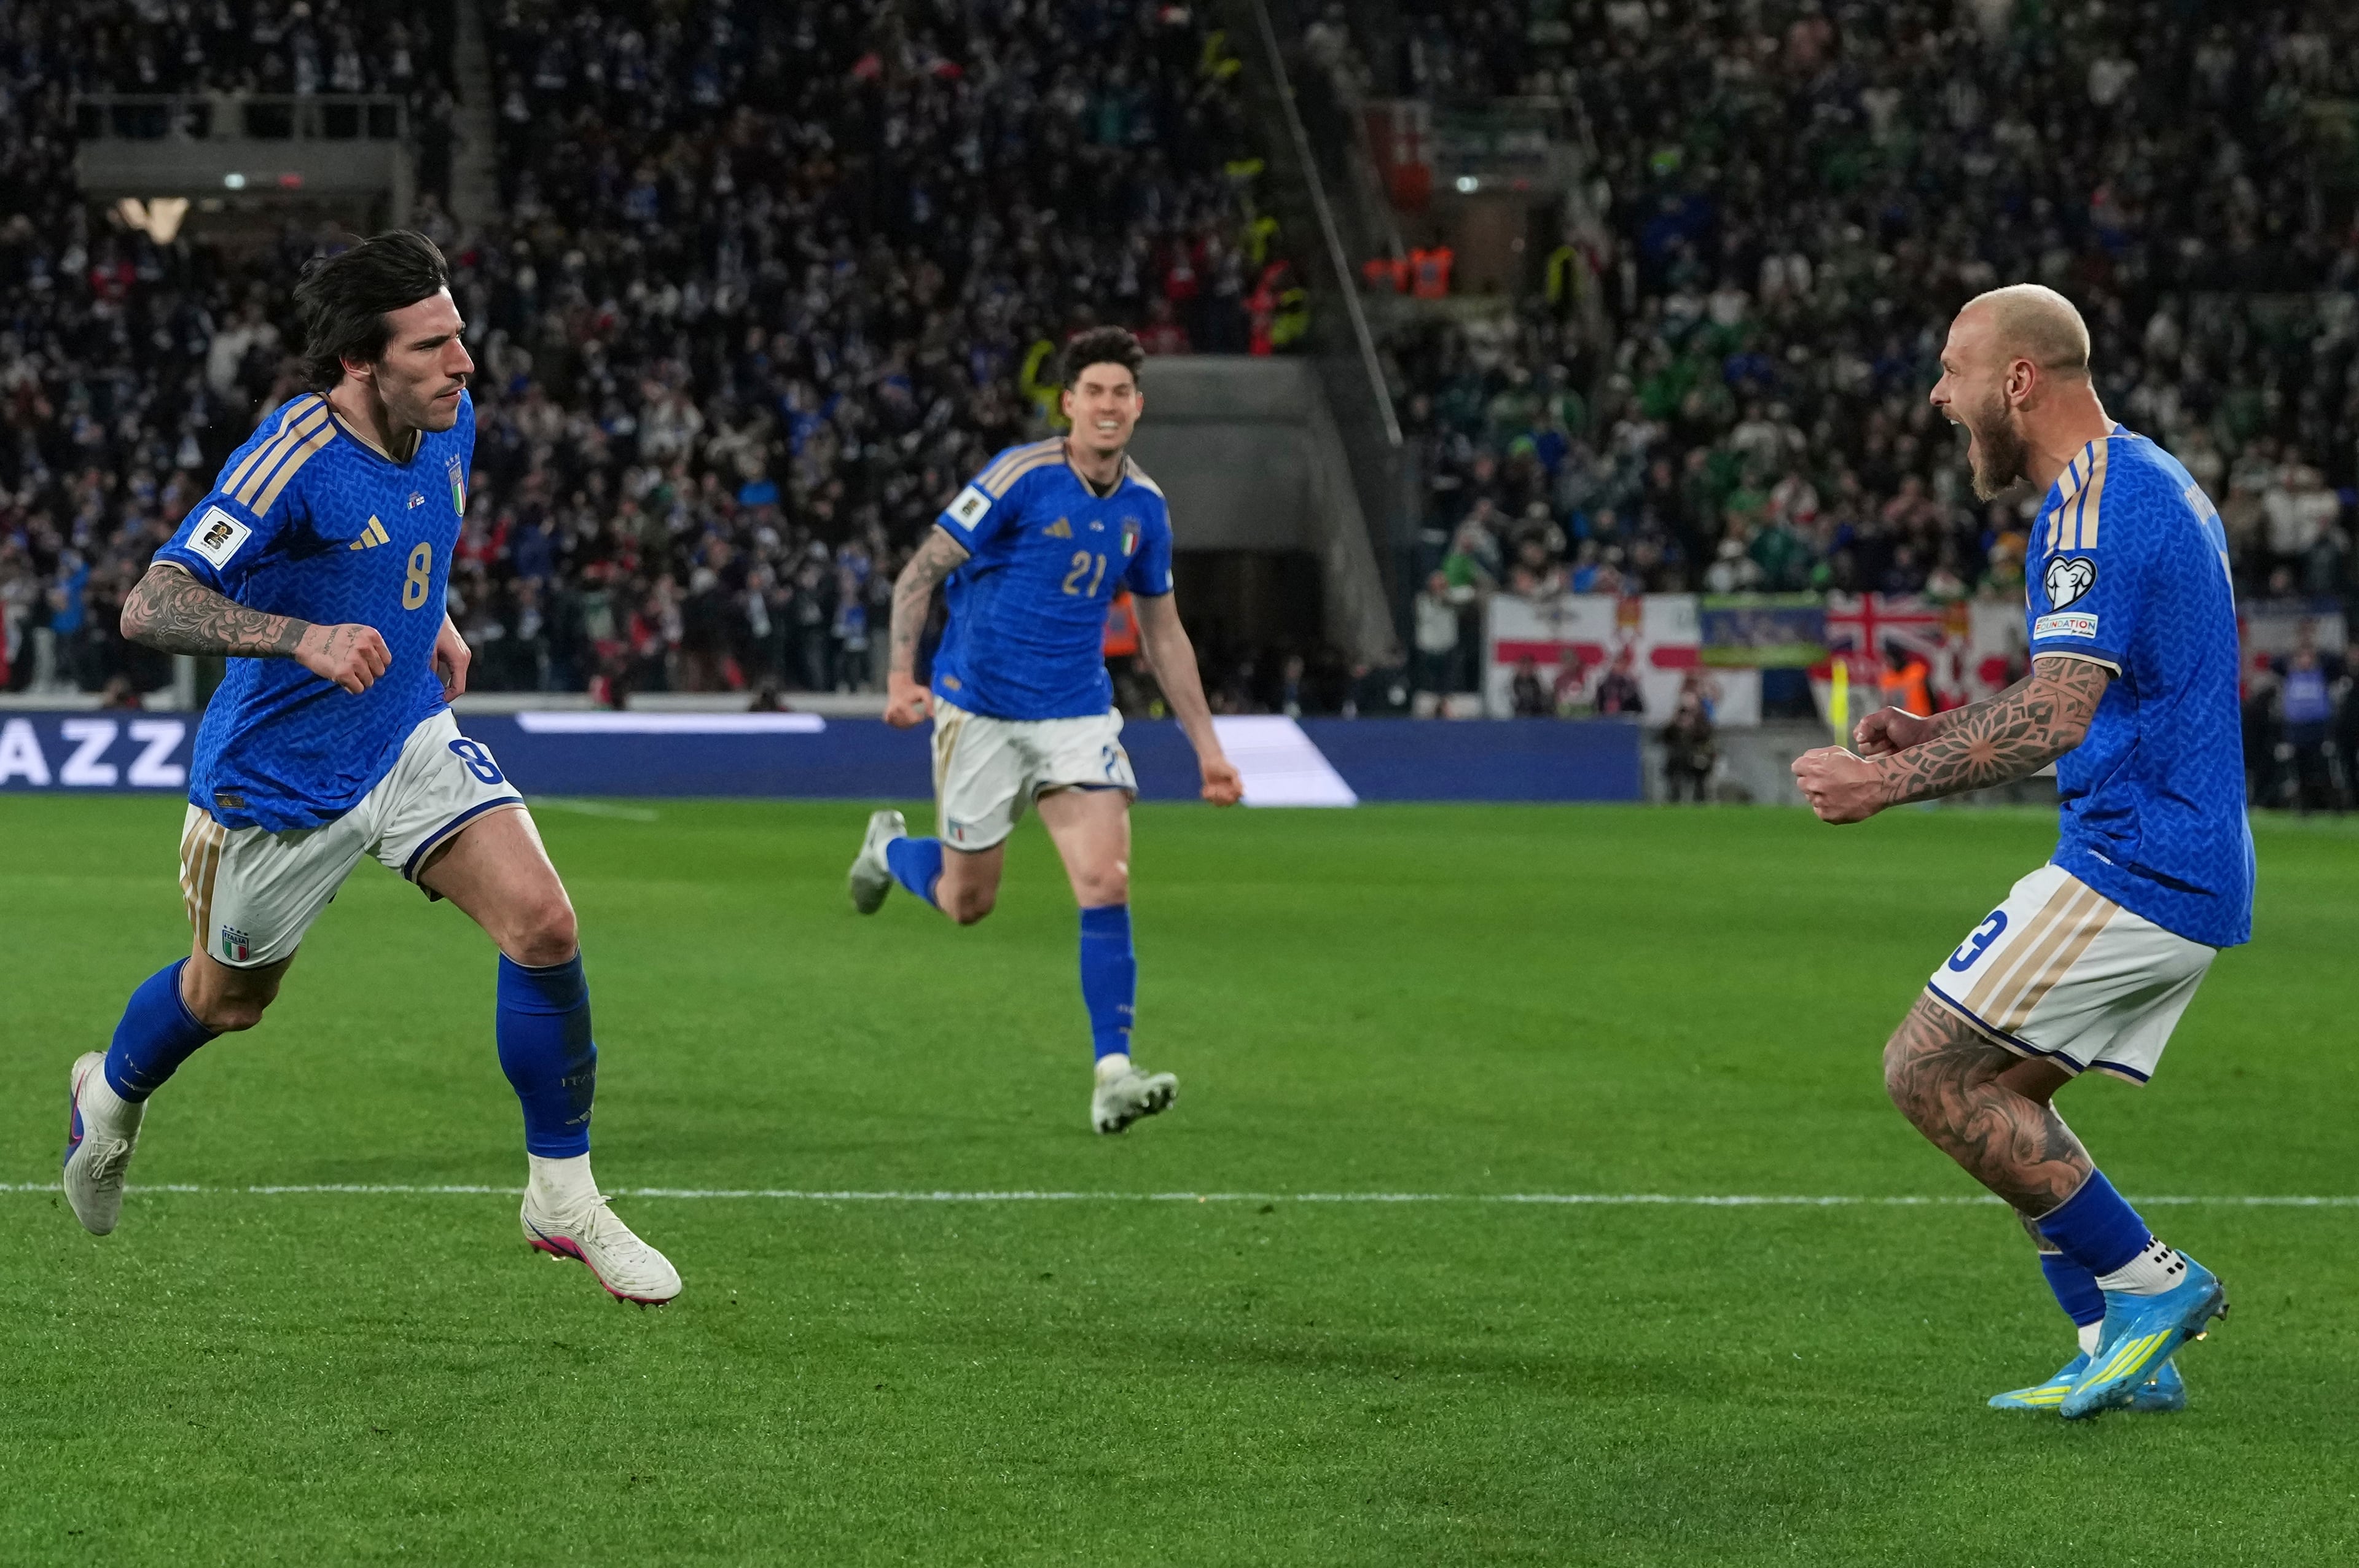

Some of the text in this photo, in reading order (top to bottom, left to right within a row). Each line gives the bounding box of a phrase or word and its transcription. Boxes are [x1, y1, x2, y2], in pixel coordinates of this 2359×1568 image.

[402, 542, 432, 610] 8
[1062, 550, 1107, 598] 21
[2036, 619, 2096, 631] FOUNDATION
[448, 739, 504, 785] 8
[224, 932, 247, 945] ITALIA
[1948, 910, 2008, 972] 3
